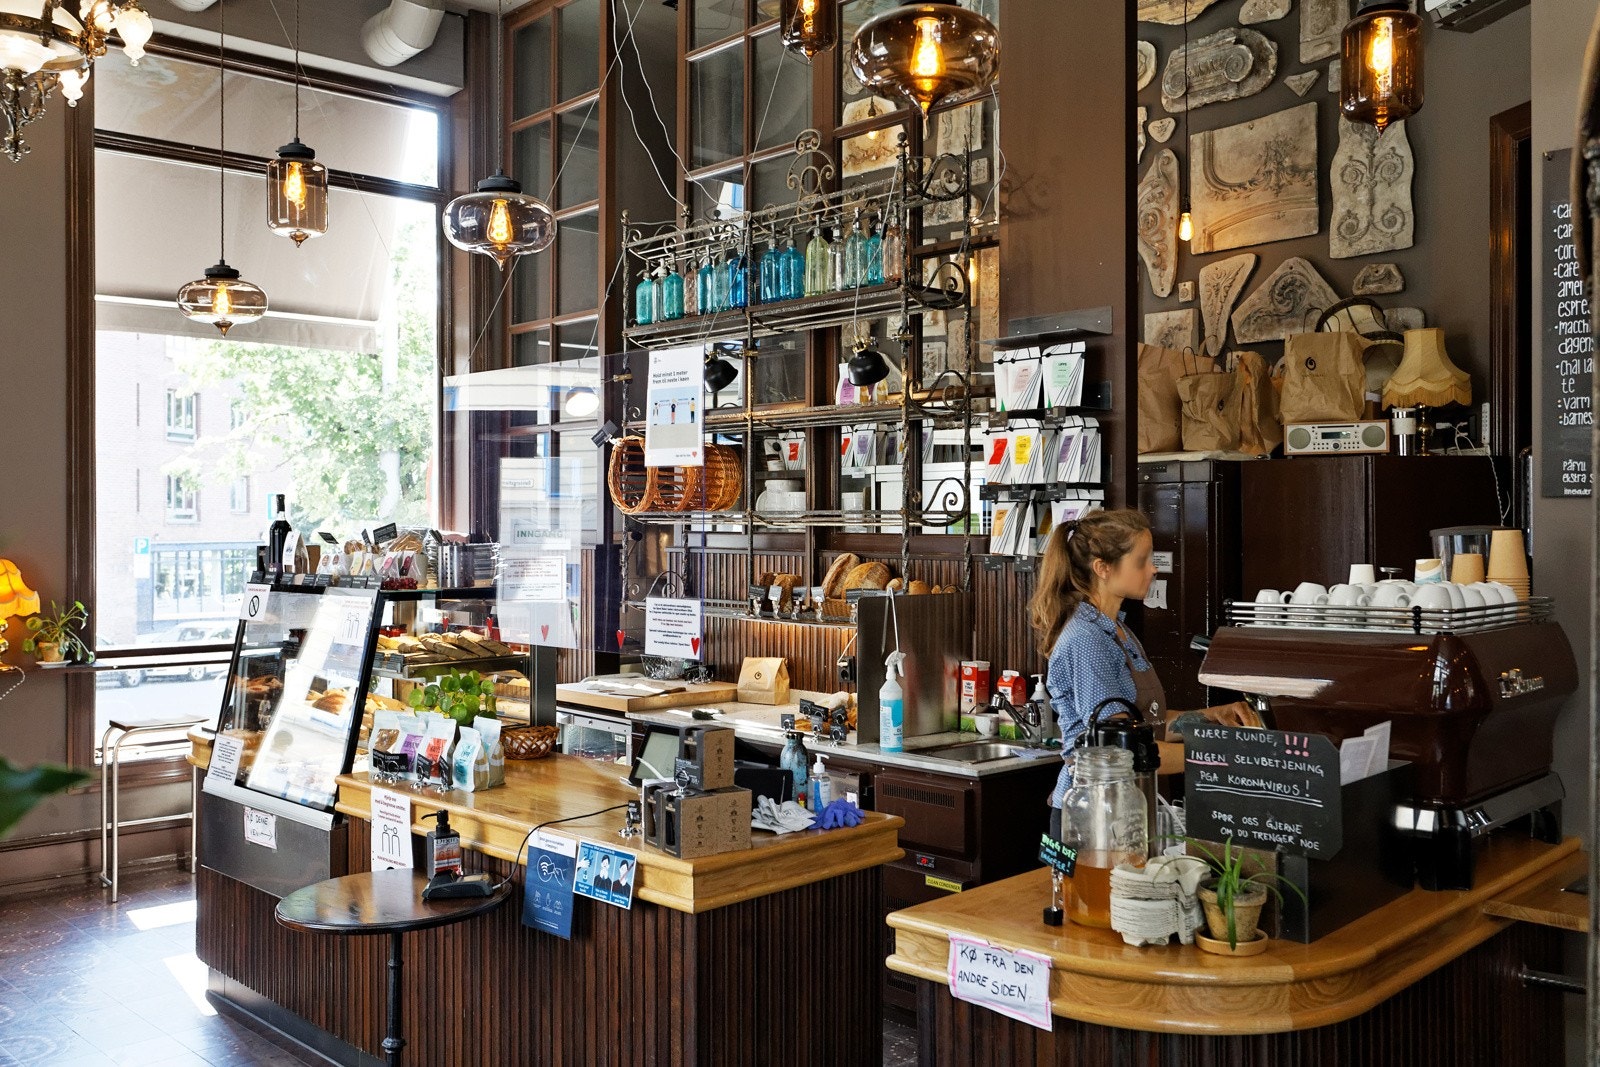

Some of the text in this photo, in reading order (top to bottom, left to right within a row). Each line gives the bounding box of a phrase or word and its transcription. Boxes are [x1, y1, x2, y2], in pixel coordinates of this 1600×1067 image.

[1558, 299, 1590, 317] espre
[516, 530, 563, 538] INNGANG
[1193, 728, 1229, 739] KJÆRE
[1190, 750, 1325, 777] INGEN SELVBETJENING
[1200, 771, 1219, 782] PGA
[1242, 816, 1259, 826] OSS
[1266, 819, 1303, 834] GJERNE
[1238, 829, 1249, 837] DU
[1252, 831, 1295, 845] TRENGER
[1300, 838, 1320, 850] NOE
[960, 945, 1034, 975] KØ FRA DEN
[958, 970, 1027, 1002] ANDRE SIDEN
